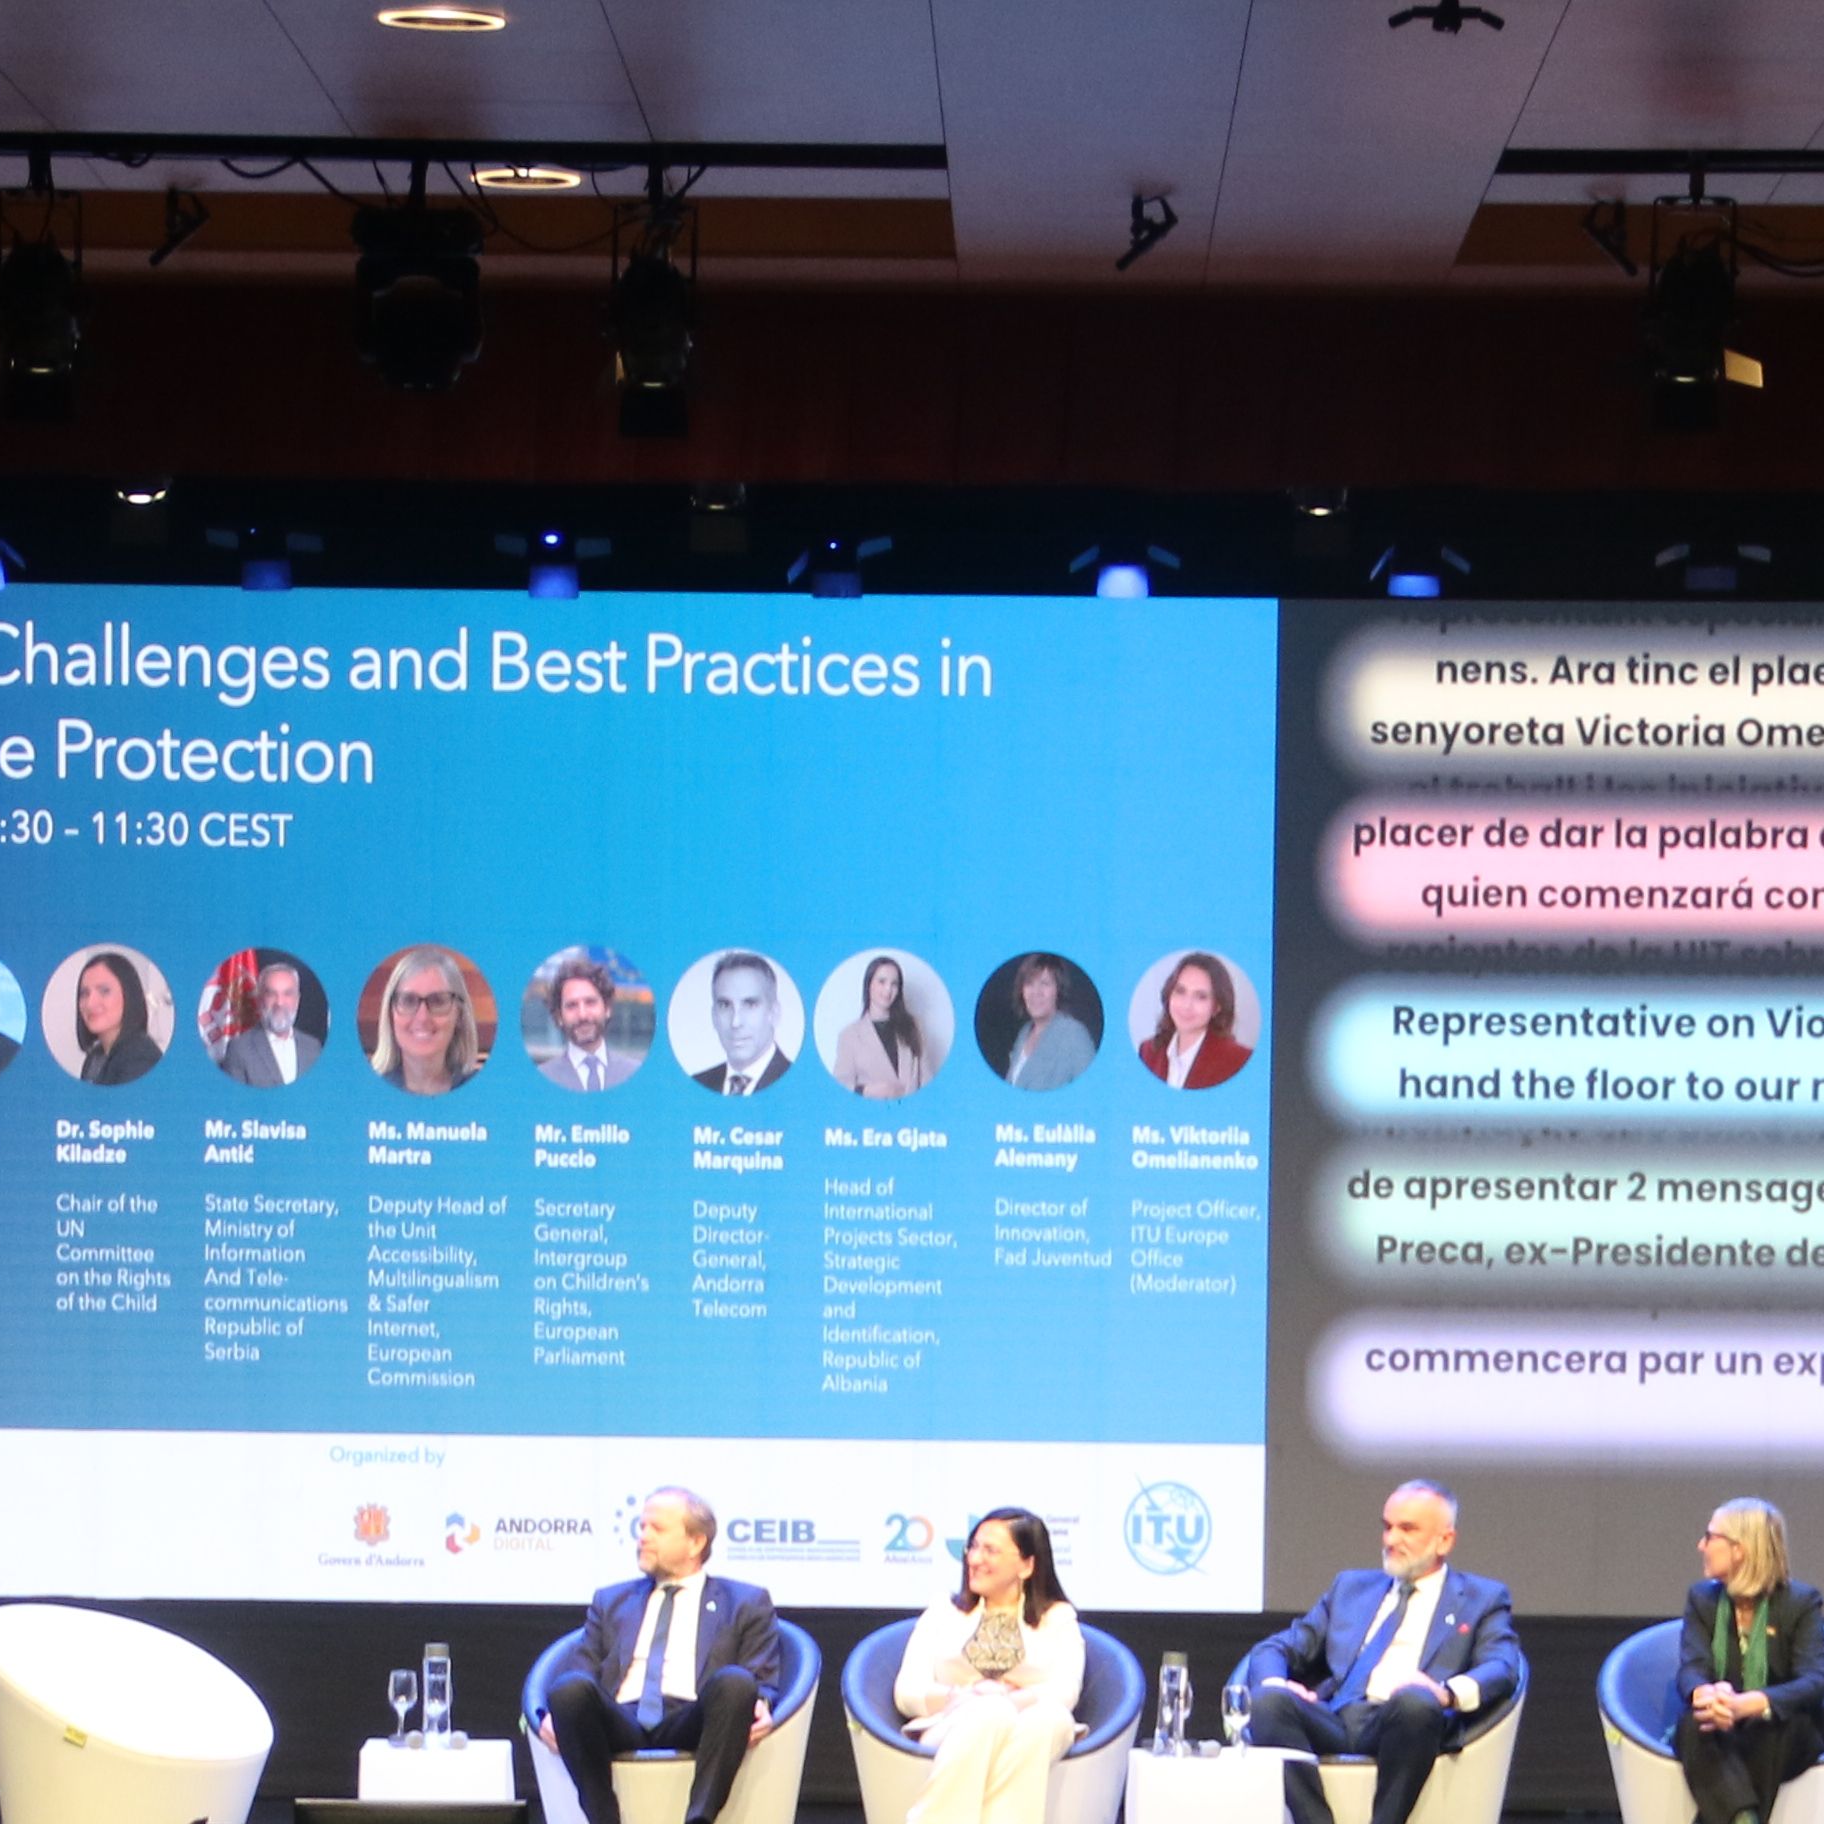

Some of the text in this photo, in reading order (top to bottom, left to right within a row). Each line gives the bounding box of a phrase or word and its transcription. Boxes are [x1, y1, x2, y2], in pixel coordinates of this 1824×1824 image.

[349, 626, 468, 692] and
[492, 630, 627, 694] Best
[647, 632, 920, 697] Practices
[941, 637, 992, 696] in
[1437, 661, 1537, 684] nens.
[1550, 656, 1615, 684] Ara
[1627, 654, 1697, 685] tinc
[1709, 656, 1740, 685] el
[1372, 718, 1564, 754] senyoreta
[1576, 714, 1725, 746] Victoria
[58, 718, 373, 783] Protection
[91, 806, 190, 843] 11:30
[199, 812, 293, 847] CEST
[1354, 818, 1474, 856] placer
[1484, 818, 1529, 847] de
[1540, 819, 1604, 848] dar
[1616, 819, 1647, 848] la
[1659, 820, 1808, 859] palabra
[1400, 1068, 1500, 1098] hand
[1512, 1069, 1574, 1099] the
[1586, 1068, 1675, 1100] floor
[1686, 1072, 1724, 1100] to
[1735, 1078, 1800, 1101] our
[56, 1119, 153, 1145] Dr. Sophie
[205, 1119, 305, 1140] Mr. Slavisa
[368, 1121, 485, 1142] Ms. Manuela
[535, 1123, 629, 1144] Mr. Emilio
[693, 1125, 781, 1146] Mr. Cesar
[824, 1126, 945, 1152] Ms. Era Gjata
[995, 1124, 1096, 1145] Ms. Eulàlia
[1132, 1125, 1250, 1146] Ms. Viktoriia
[57, 1143, 125, 1164] Kiladze
[205, 1144, 254, 1165] Antić
[369, 1144, 431, 1165] Martra
[534, 1148, 595, 1169] Puccio
[693, 1150, 782, 1176] Marquina
[996, 1148, 1076, 1174] Alemany
[1133, 1149, 1257, 1170] Omelianenko
[56, 1192, 157, 1213] Chair of the
[995, 1197, 1089, 1218] Director of
[1132, 1198, 1260, 1224] Project Officer,
[693, 1223, 768, 1244] Director-
[994, 1222, 1090, 1246] Innovation,
[1131, 1223, 1228, 1249] ITU Europe
[56, 1242, 153, 1263] Committee
[995, 1246, 1112, 1267] Fad Juventud
[1377, 1235, 1493, 1268] Preca,
[1505, 1234, 1775, 1266] ex-Presidente
[56, 1266, 171, 1292] on the Rights
[368, 1267, 498, 1293] Multilingualism
[823, 1274, 942, 1300] Development
[1131, 1272, 1236, 1298] (Moderator)
[56, 1291, 157, 1312] of the Child
[204, 1292, 348, 1313] communications
[367, 1366, 475, 1387] Commission
[329, 1446, 446, 1467] Organized by
[494, 1518, 593, 1536] ANDORRA
[727, 1518, 816, 1544] CEIB
[1132, 1513, 1205, 1545] ITU
